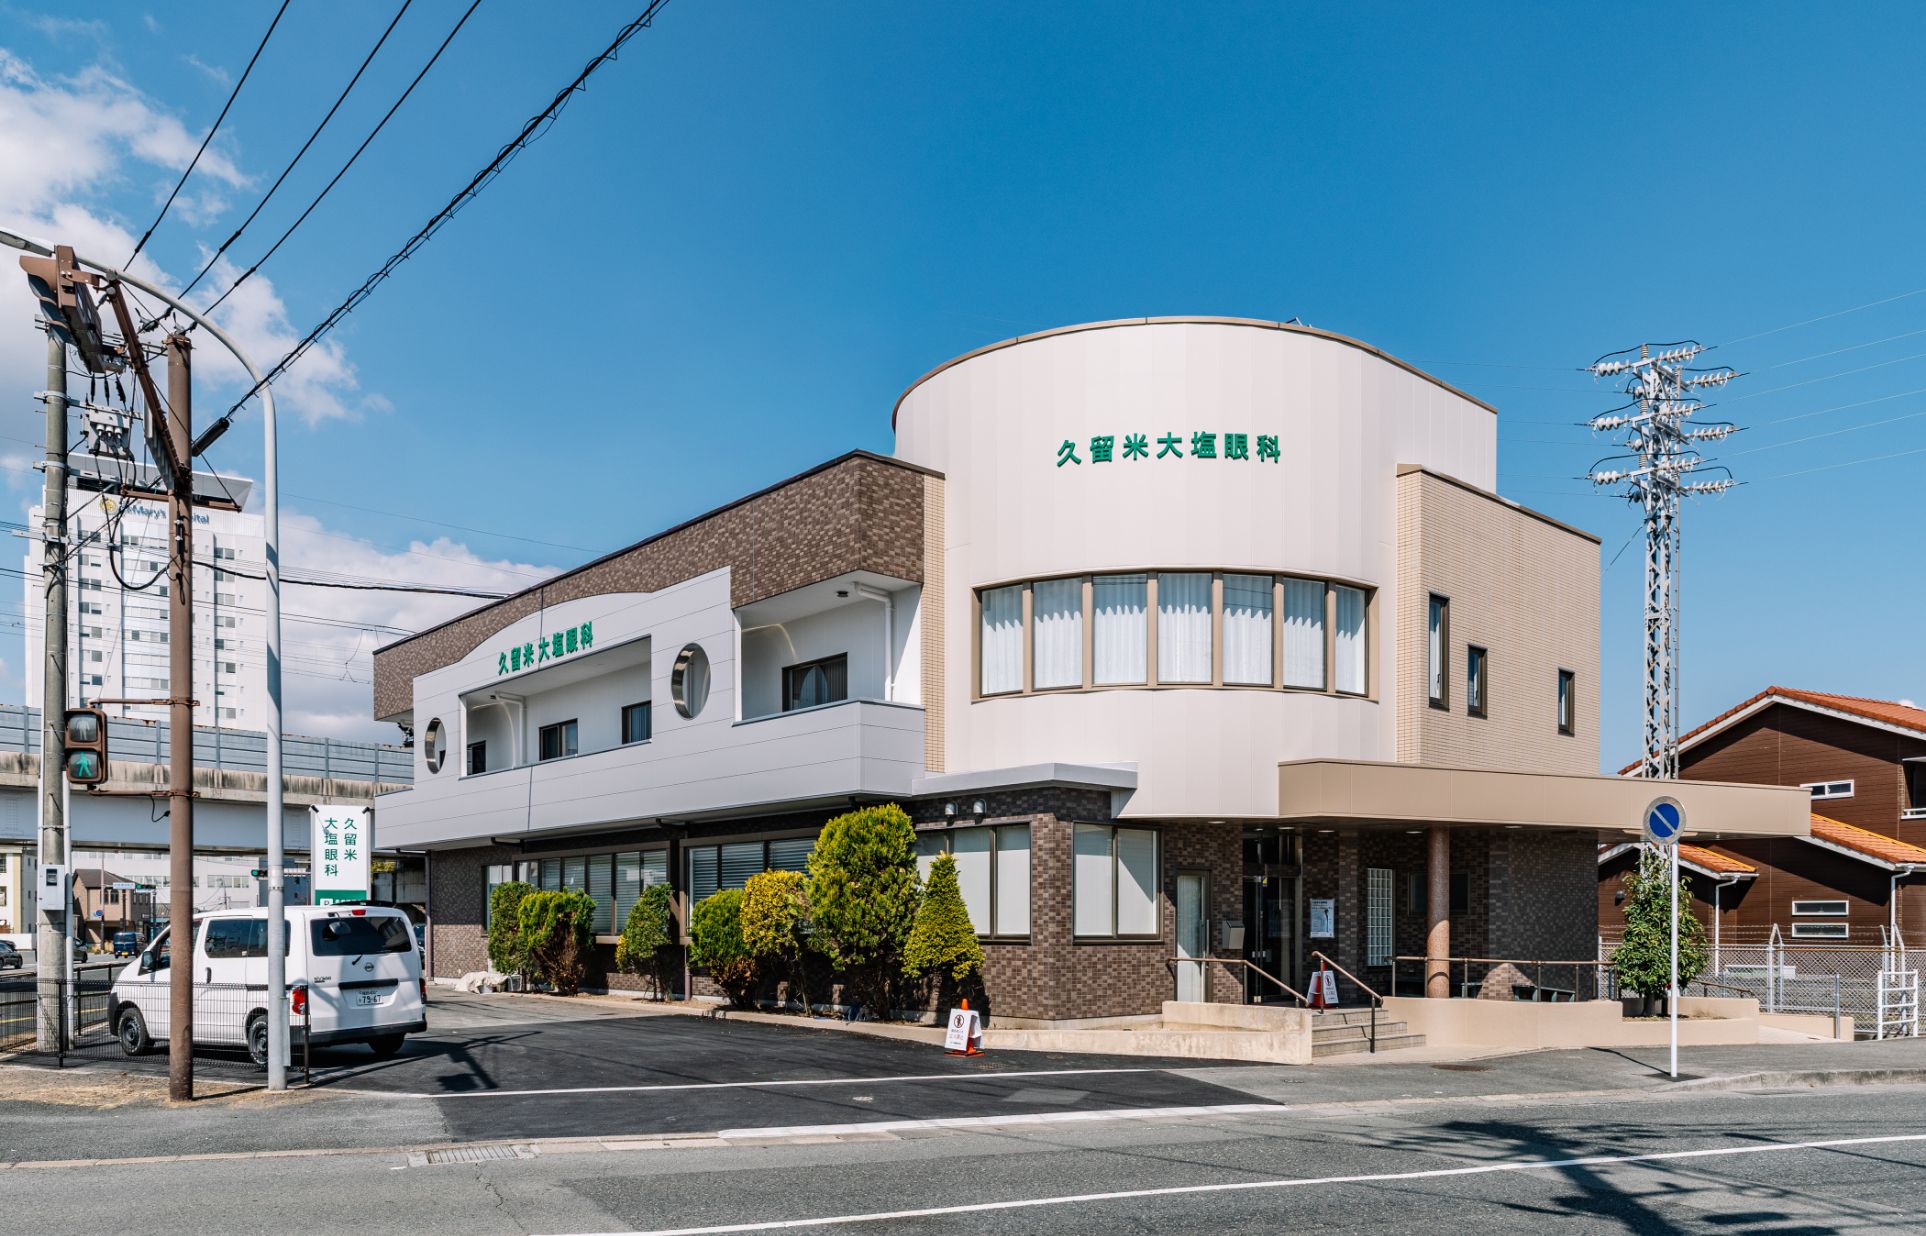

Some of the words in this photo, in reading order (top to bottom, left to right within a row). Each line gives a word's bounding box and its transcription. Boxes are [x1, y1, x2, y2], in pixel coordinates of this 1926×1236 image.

[1057, 431, 1280, 467] 久留米大塩眼科
[498, 621, 592, 675] 久留米大塩眼科
[324, 818, 338, 877] 大塩眼科
[344, 818, 357, 861] 久留米
